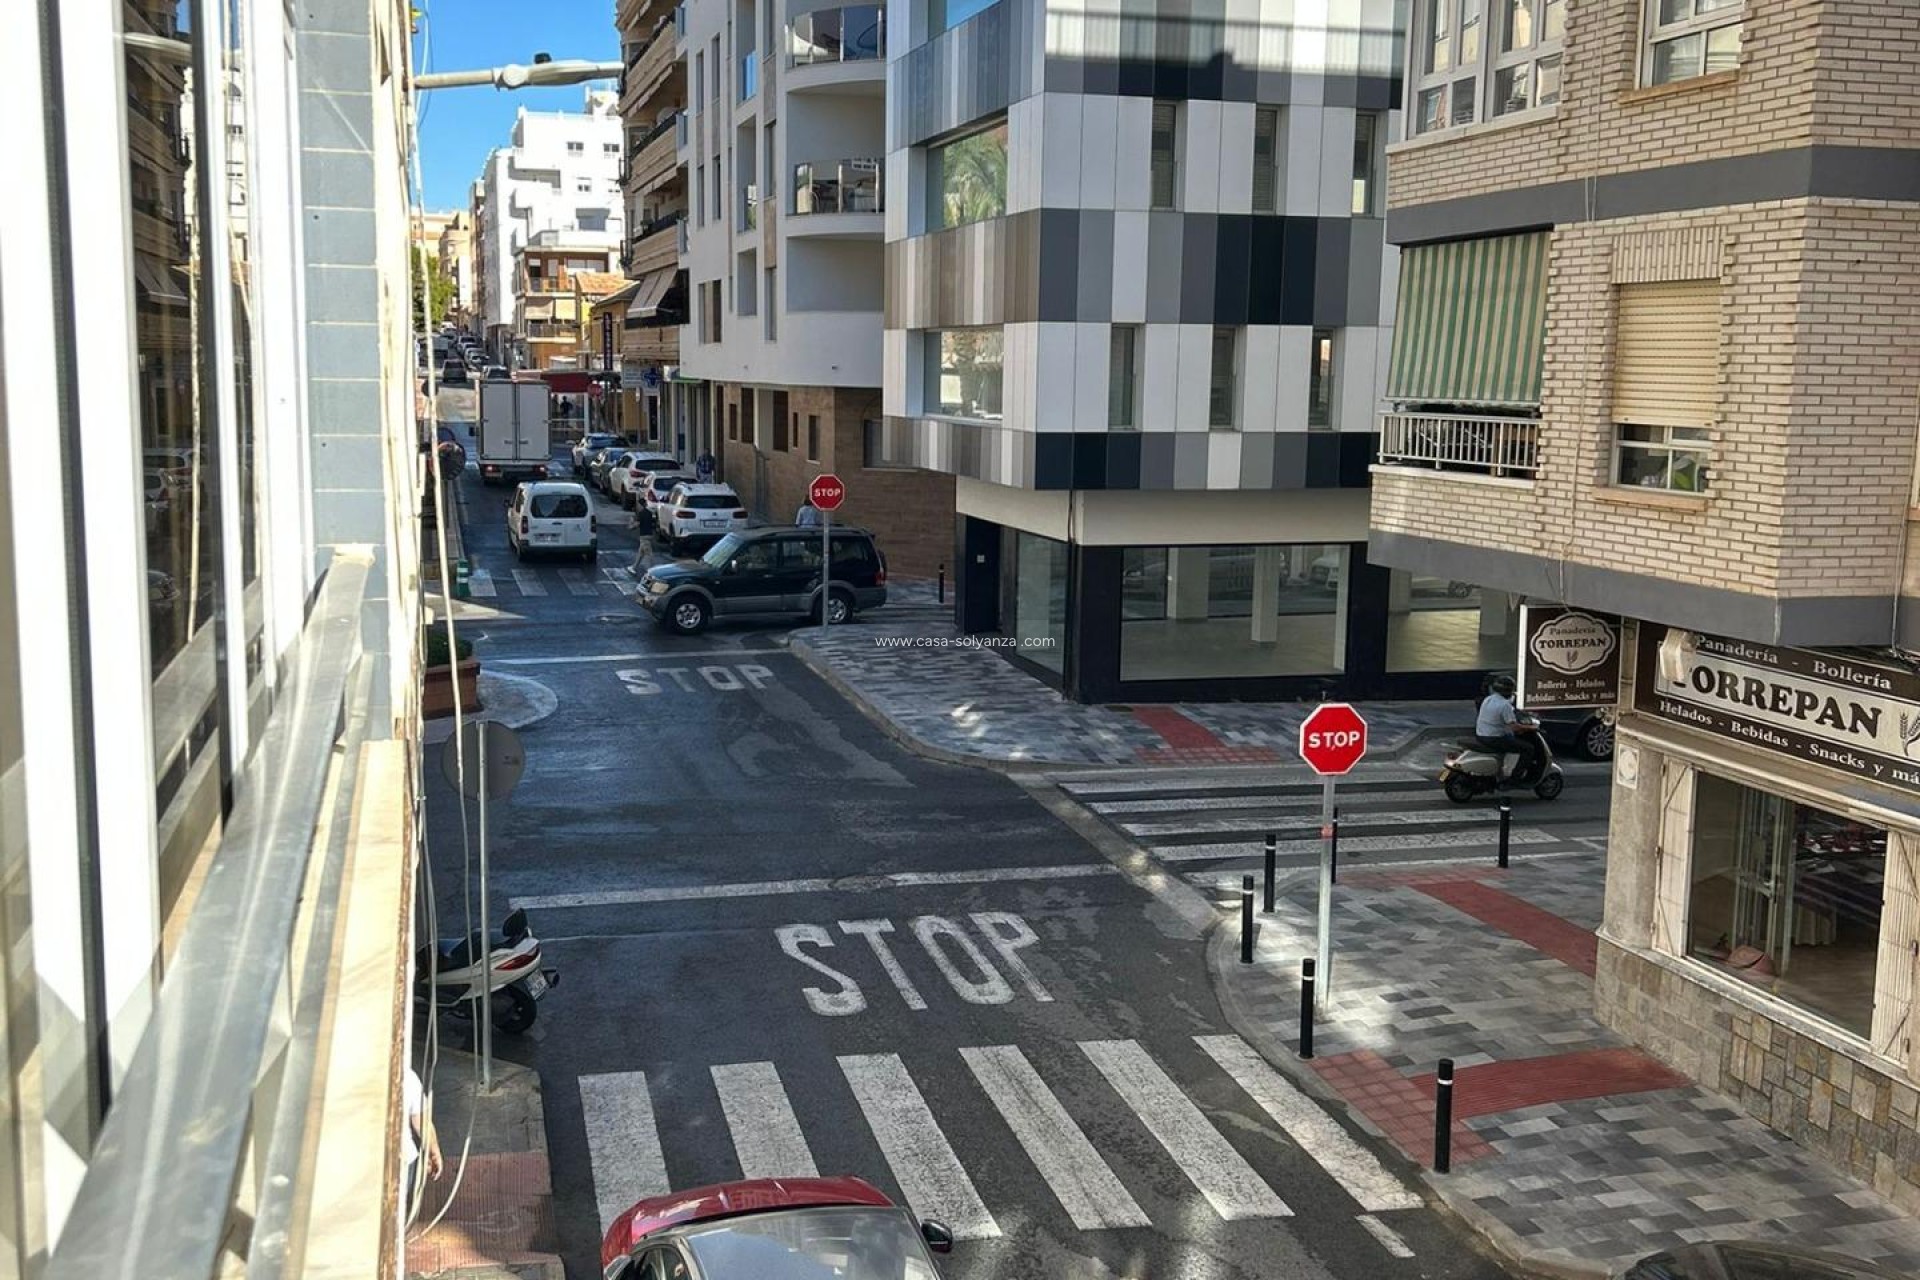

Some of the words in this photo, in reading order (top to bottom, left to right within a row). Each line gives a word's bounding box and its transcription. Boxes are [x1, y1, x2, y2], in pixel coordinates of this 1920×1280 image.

[814, 487, 841, 497] STOP
[1539, 638, 1607, 649] TORREPAN
[1696, 634, 1778, 664] Panadería
[1813, 660, 1892, 690] Bollería
[615, 664, 774, 695] STOP
[1673, 665, 1882, 739] ORREPAN
[1308, 731, 1361, 749] STOP
[1660, 700, 1712, 725] Helados
[1731, 720, 1789, 748] Bebidas
[1810, 743, 1866, 769] Snacks
[1873, 763, 1884, 777] y
[774, 911, 1055, 1017] STOP
